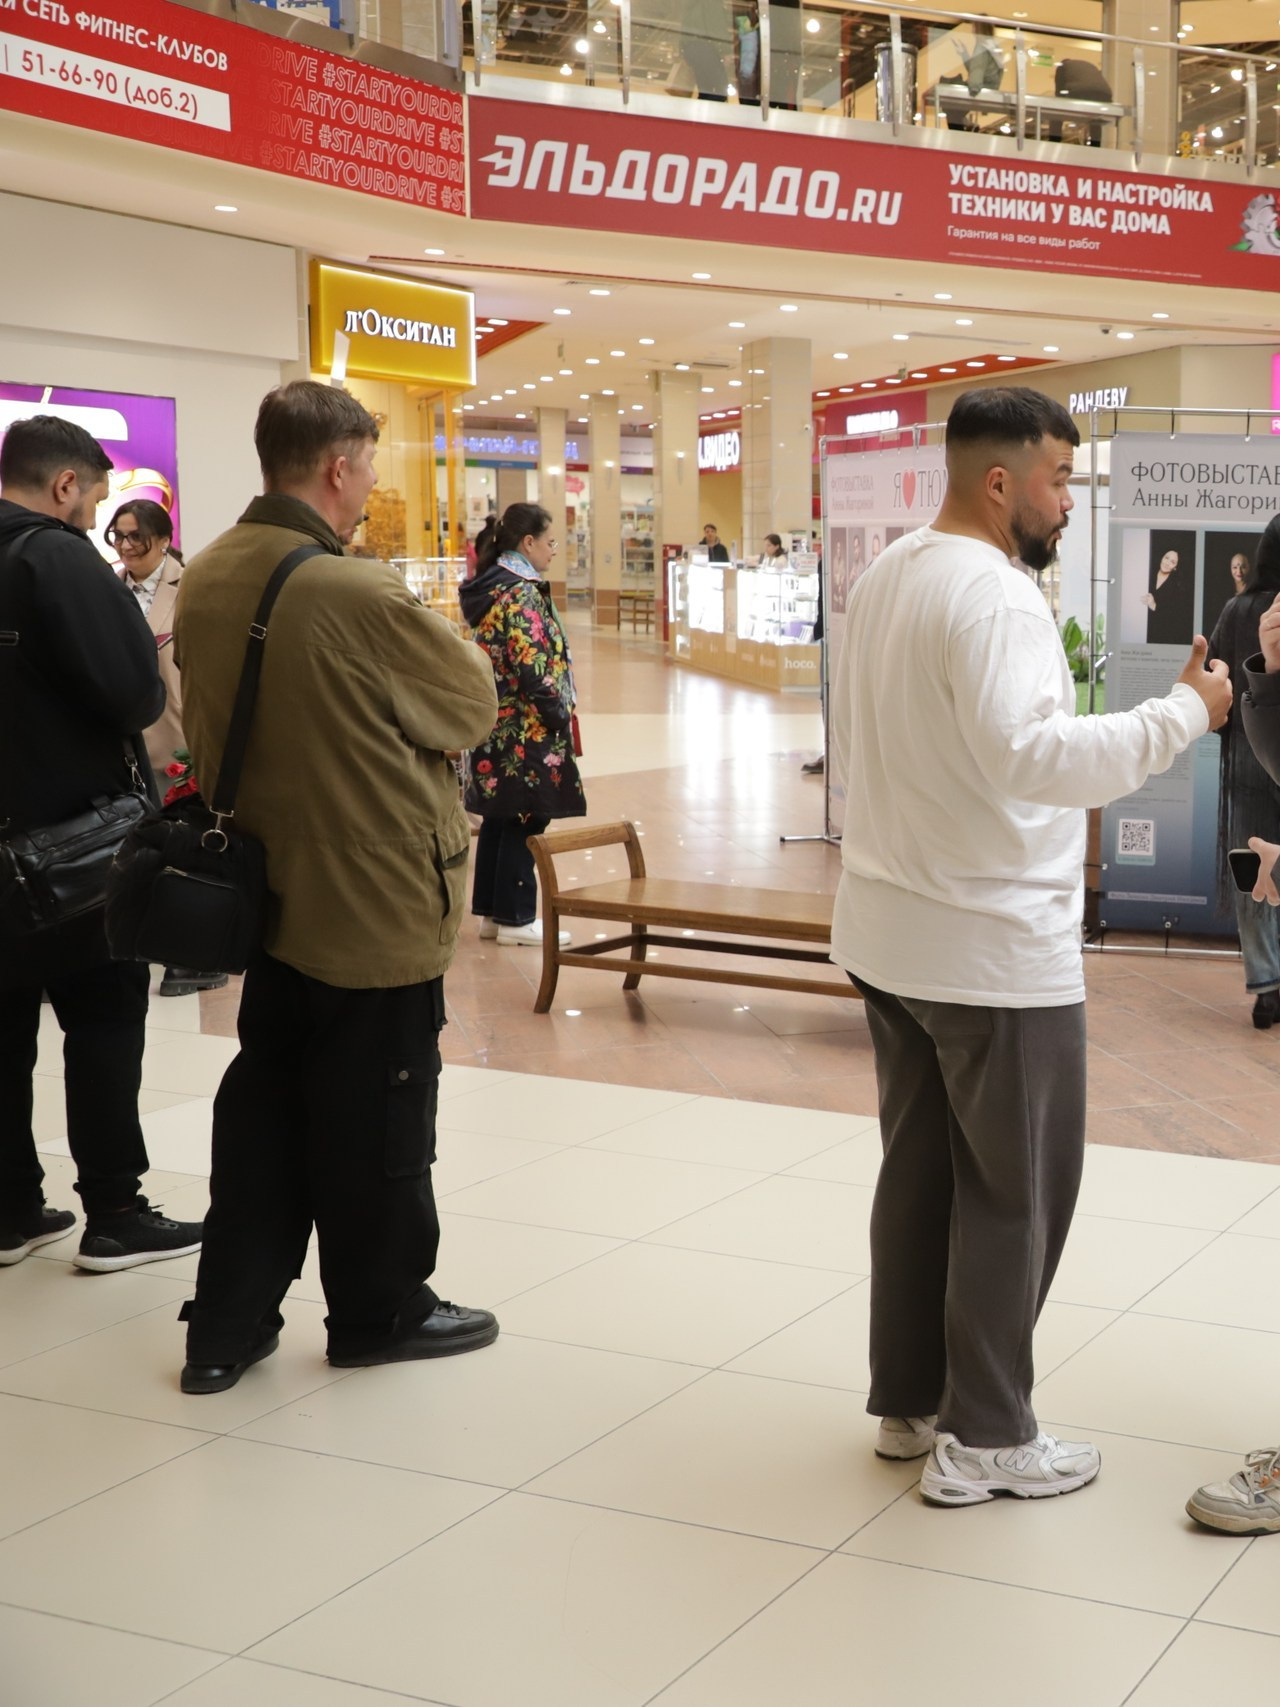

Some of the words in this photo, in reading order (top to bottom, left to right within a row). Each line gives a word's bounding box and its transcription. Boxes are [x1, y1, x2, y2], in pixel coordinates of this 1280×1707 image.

[23, 0, 70, 25] СЕТЬ
[75, 11, 228, 71] ФИТНЕС-КЛУБОВ
[21, 50, 118, 94] 51-66-90
[125, 77, 198, 120] (доб.2)
[477, 134, 902, 226] ЭЛЬДОРАДО.RU
[949, 163, 1070, 198] УСТАНОВКА
[1077, 174, 1093, 199] И
[1098, 181, 1214, 213] НАСТРОЙКА
[948, 192, 1046, 223] ТЕХНИКИ
[1051, 202, 1065, 225] У
[1068, 204, 1108, 229] ВАС
[1111, 208, 1171, 235] ДОМА
[947, 225, 999, 243] Гарантия
[1000, 233, 1015, 242] на
[1017, 235, 1037, 244] все
[1039, 236, 1067, 248] виды
[1068, 237, 1101, 251] работ
[1069, 386, 1128, 414] РАНДЕВУ
[1132, 488, 1189, 508] Анны
[784, 656, 817, 669] hoco.
